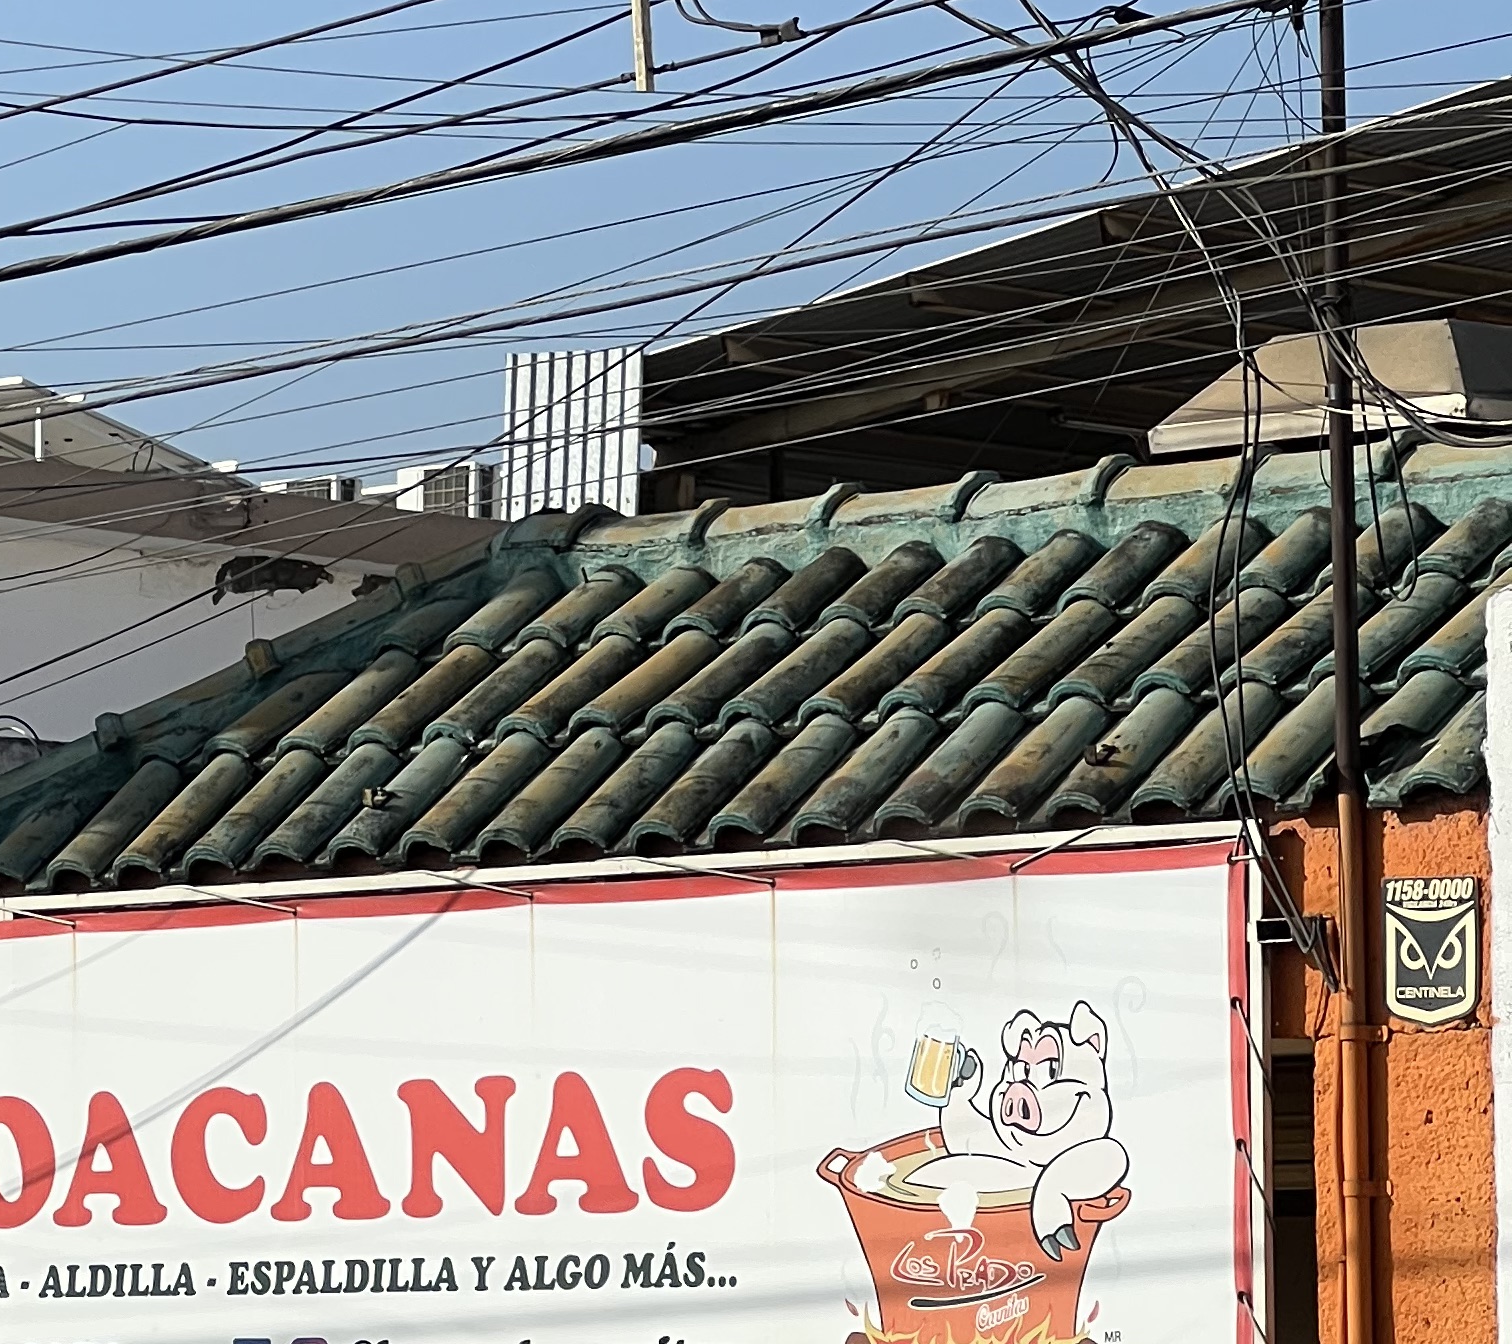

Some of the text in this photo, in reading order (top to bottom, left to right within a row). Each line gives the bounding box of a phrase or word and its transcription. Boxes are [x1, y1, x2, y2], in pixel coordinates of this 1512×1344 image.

[1386, 878, 1474, 902] 1158-0000
[1396, 986, 1465, 999] CENTINELA
[38, 1262, 197, 1299] ALDILLA
[226, 1256, 459, 1296] ESPALDILLA
[470, 1256, 496, 1292] Y
[503, 1253, 611, 1291] ALGO
[620, 1241, 737, 1289] MÁS...
